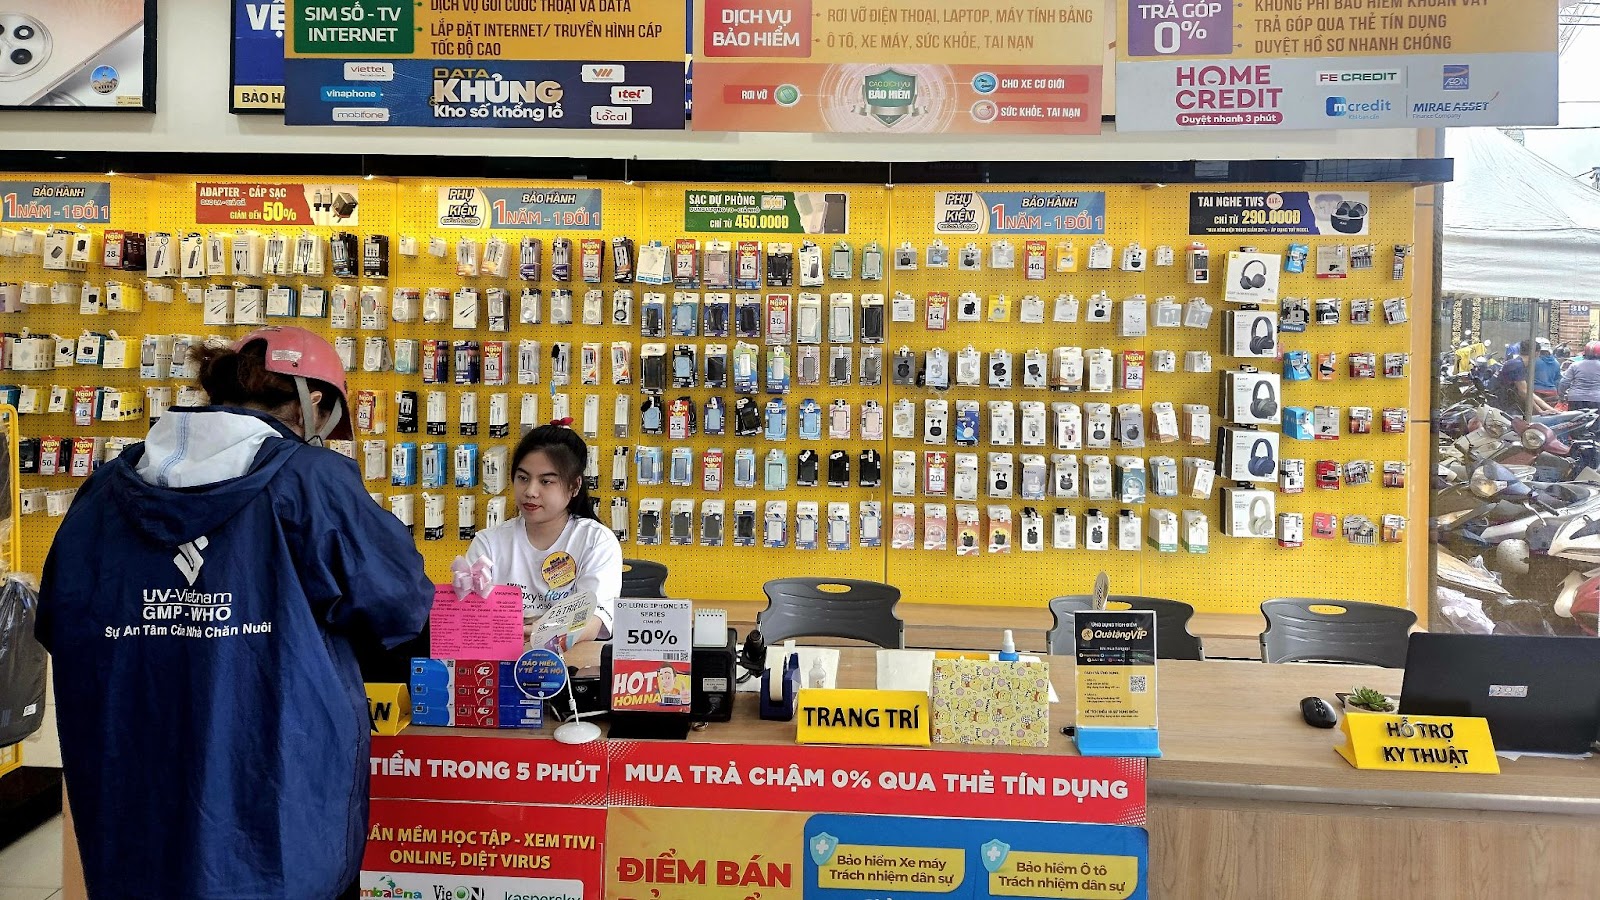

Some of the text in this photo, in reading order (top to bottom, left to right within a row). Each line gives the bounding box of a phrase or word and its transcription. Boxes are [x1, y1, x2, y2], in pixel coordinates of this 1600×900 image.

[305, 2, 402, 21] SIM SỐ TV
[722, 9, 792, 27] DỊCH VỤ
[828, 5, 1093, 25] RƠI VỠ ĐIỆN THOẠI, LAPTOP, MÁY TÍNH BẢNG
[1137, 0, 1221, 20] TRẢ GÓP
[431, 17, 454, 37] LẮP
[457, 21, 480, 40] ĐẶT
[556, 18, 602, 38] TRUYỀN
[605, 21, 635, 38] HÌNH
[638, 19, 662, 38] CÁP
[1255, 12, 1447, 33] TRẢ GÓP QUA THẺ TÍN DỤNG
[308, 28, 398, 42] INTERNET
[712, 25, 800, 47] BẢO HIỂM
[1154, 21, 1207, 54] 0%
[431, 38, 501, 58] TỐC ĐỘ CAO
[351, 65, 386, 73] viettel
[434, 68, 490, 78] DATA
[1176, 65, 1270, 86] HOME
[1320, 72, 1397, 82] FE CREDIT
[326, 89, 376, 99] vinaphone
[433, 72, 564, 104] KHỦNG
[1175, 88, 1283, 110] CREDIT
[1413, 101, 1489, 112] MIRAE ASSET
[434, 102, 564, 121] Kho số khổng lồ
[596, 111, 627, 121] Local
[1182, 113, 1277, 125] Duyệt nhanh 3 phút
[199, 185, 287, 200] ADAPTER CÁP SẠC
[448, 188, 475, 202] PHỤ
[521, 192, 576, 204] BẢO HÀNH
[689, 195, 707, 207] SẠC
[708, 194, 723, 207] DỰ
[724, 193, 756, 205] PHÒNG
[1198, 196, 1213, 207] TAI
[1216, 196, 1243, 207] NGHE
[1244, 196, 1264, 207] TWS
[448, 203, 478, 218] KIỆN
[1021, 196, 1079, 208] BẢO HÀNH
[263, 201, 297, 222] 50%
[1571, 304, 1588, 312] 310
[42, 459, 52, 467] 50
[142, 588, 232, 604] UV-Vietnam
[105, 625, 120, 639] Sự
[123, 625, 140, 637] An
[143, 624, 167, 636] Tâm
[205, 624, 238, 639] Chăn
[242, 621, 272, 634] Nuôi
[627, 629, 678, 645] 50%
[613, 670, 658, 695] HOT
[803, 704, 920, 729] TRANG TRÍ
[1416, 721, 1455, 743] TRỢ
[1410, 745, 1469, 769] THUẬT
[370, 750, 601, 783] TIỀN TRONG 5 PHÚT
[625, 760, 1128, 804] MUA TRẢ CHẬM 0% QUA THẺ TÍN DỤNG
[397, 825, 595, 850] MỀM HỌC TẬP XEM TIVI
[390, 849, 551, 871] ONLINE, DIỆT VIRUS
[616, 847, 793, 889] ĐIỂM BÁN
[837, 855, 947, 872] Bảo hiểm Xe máy
[1016, 860, 1107, 876] Bảo hiểm Ô tô
[830, 869, 954, 887] Trách nhiệm dân sự
